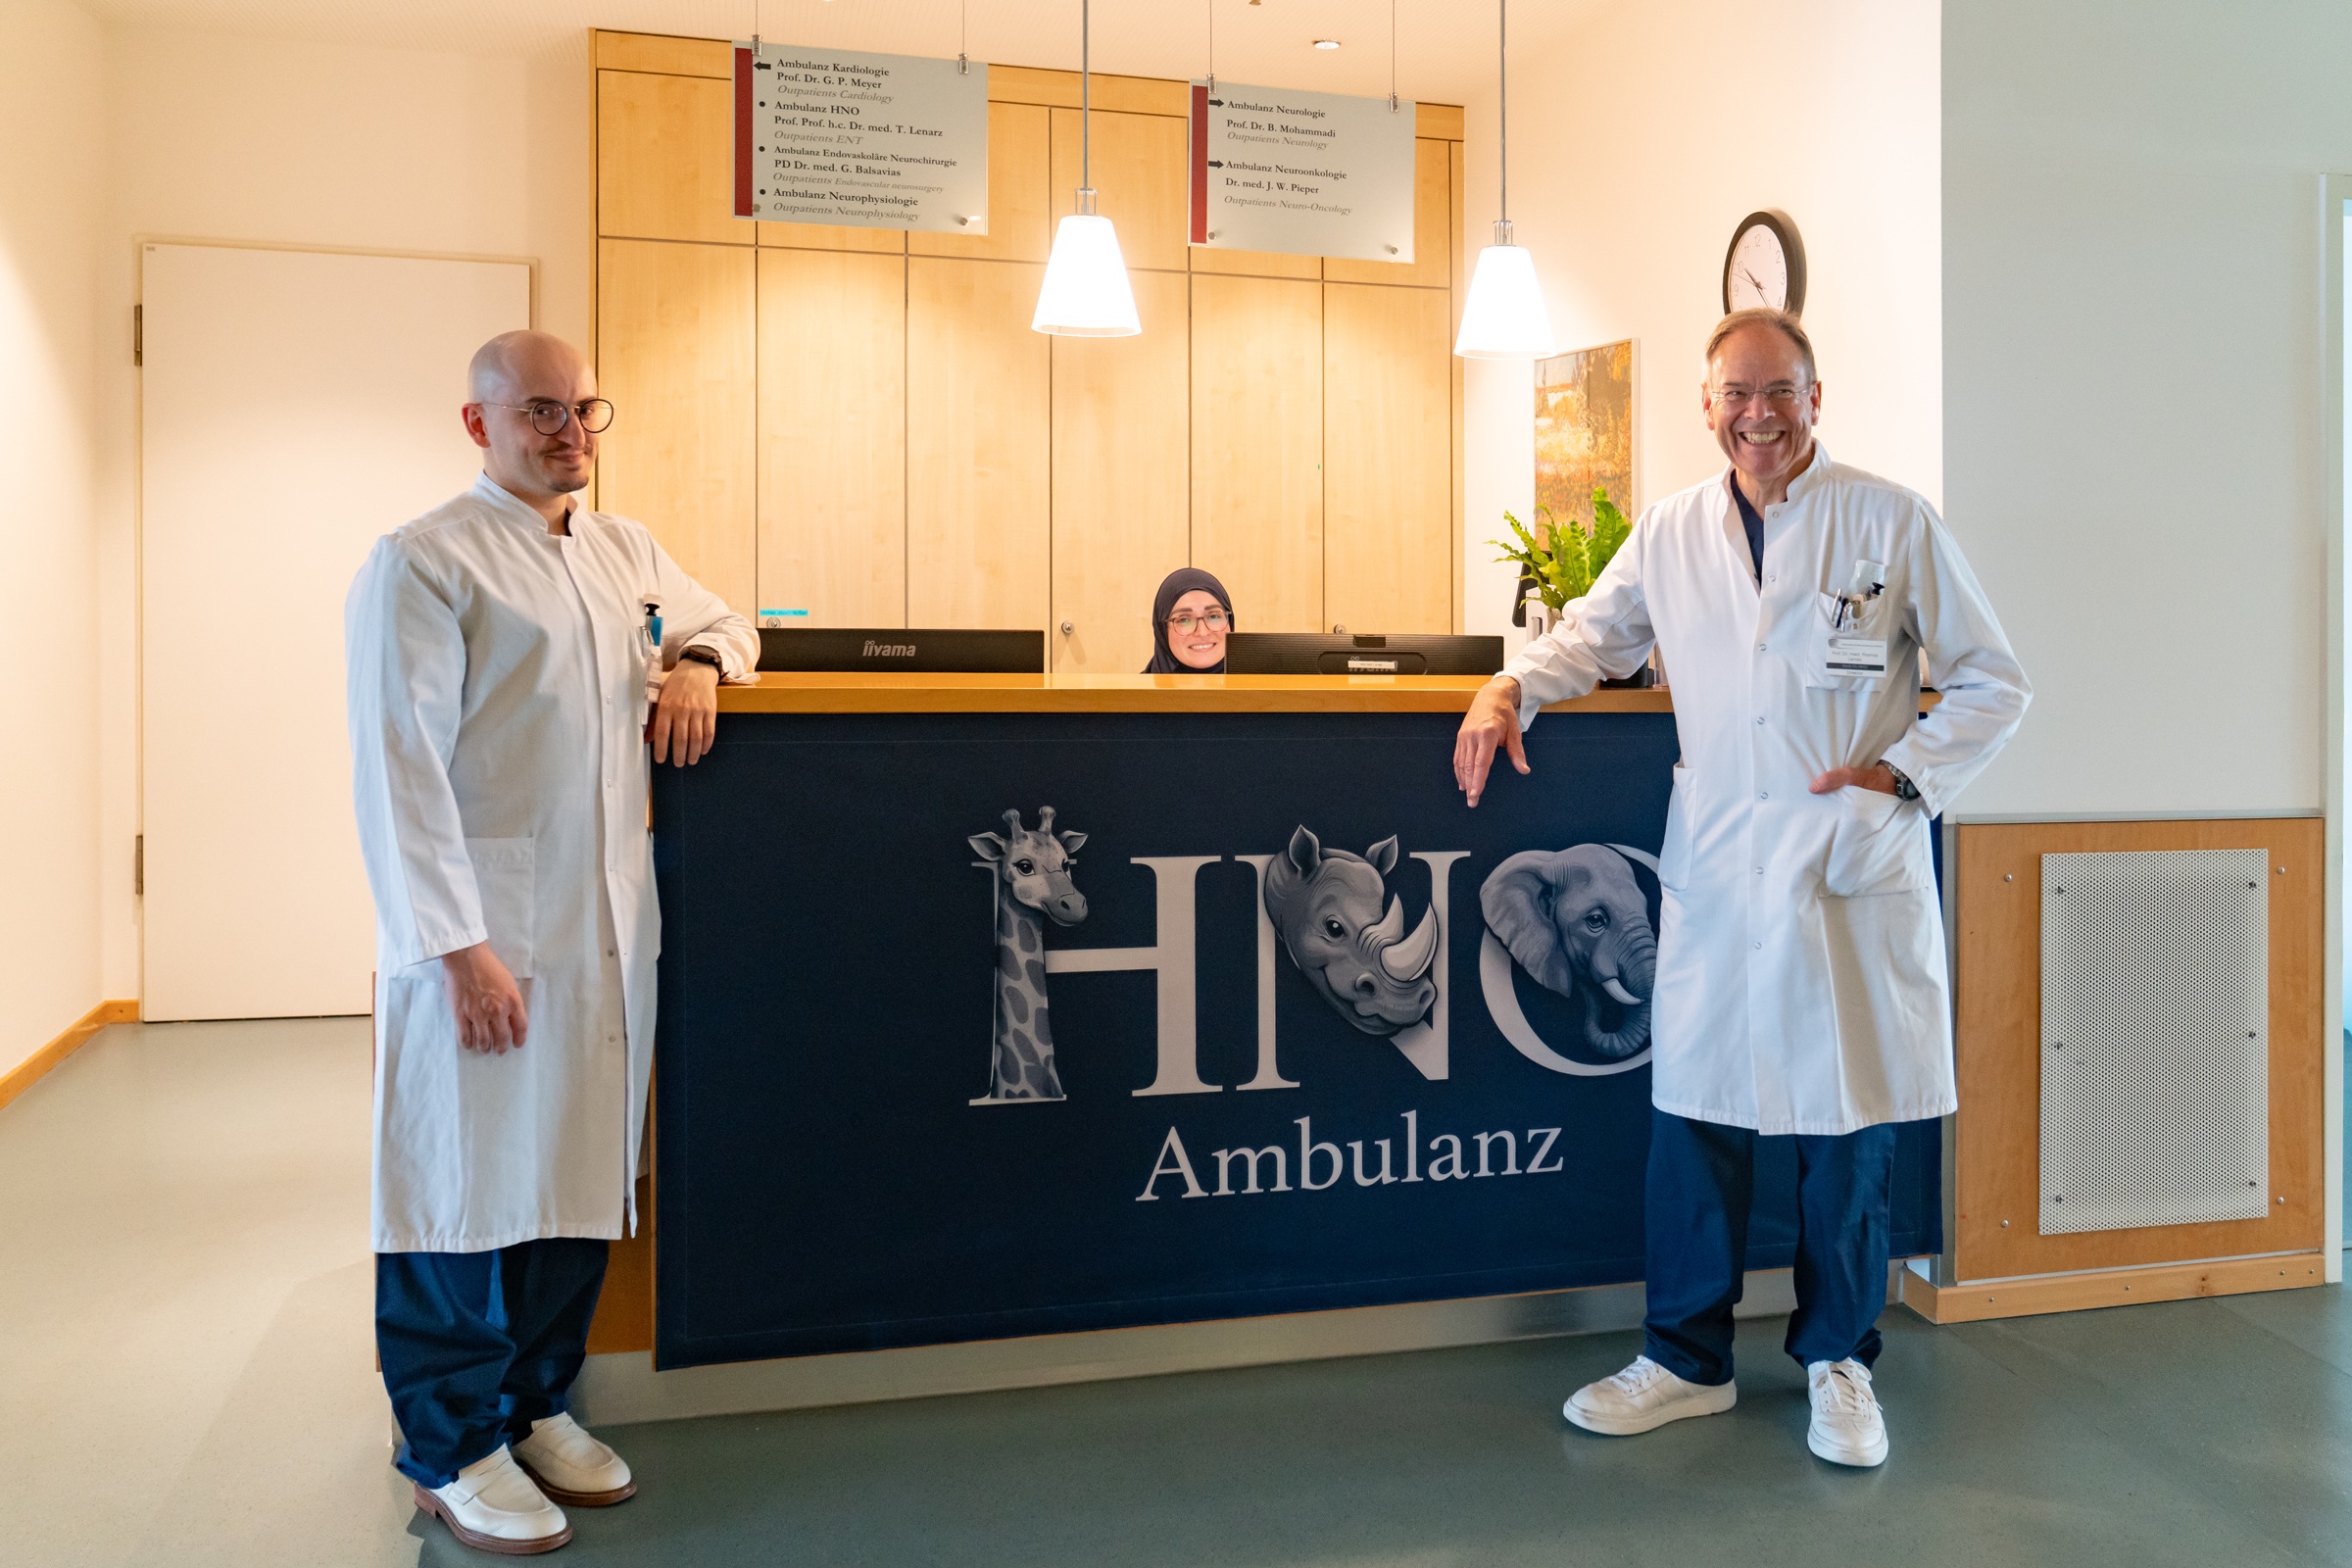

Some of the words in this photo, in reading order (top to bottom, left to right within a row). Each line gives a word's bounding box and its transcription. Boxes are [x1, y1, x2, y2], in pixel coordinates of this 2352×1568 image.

[777, 59, 829, 71] Ambulanz
[832, 63, 890, 77] Kardiologie
[777, 72, 801, 82] Prof.
[804, 74, 820, 83] Dr.
[823, 75, 835, 85] G.
[838, 77, 848, 86] P.
[851, 78, 882, 90] Meyer
[778, 84, 837, 98] Outpatients
[840, 90, 894, 104] Cardiology
[774, 101, 827, 113] Ambulanz
[830, 105, 859, 116] HNO
[1228, 100, 1274, 113] Ambulanz
[1276, 105, 1326, 120] Neurologie
[774, 116, 799, 126] Prof.
[802, 118, 825, 128] Prof.
[828, 120, 846, 129] h.c.
[850, 121, 865, 131] Dr.
[868, 124, 893, 133] med.
[896, 124, 906, 134] T.
[909, 125, 943, 137] Lenarz
[1227, 119, 1248, 129] Prof.
[1250, 122, 1265, 131] Dr.
[1267, 122, 1277, 132] B.
[1280, 124, 1336, 138] Mohammadi
[774, 130, 833, 143] Outpatients
[837, 135, 863, 145] ENT
[1227, 131, 1280, 144] Outpatients
[1282, 136, 1329, 151] Neurology
[774, 146, 820, 157] Ambulanz
[823, 149, 888, 161] Endovaskoläre
[890, 154, 957, 168] Neurochirurgie
[774, 160, 791, 169] PD
[794, 161, 810, 171] Dr.
[812, 164, 838, 172] med.
[841, 165, 853, 173] G.
[856, 165, 901, 176] Balsavias
[1226, 161, 1272, 172] Ambulanz
[1275, 165, 1348, 181] Neuroonkologie
[773, 172, 833, 184] Outpatients
[835, 177, 890, 189] Endovascular
[891, 183, 945, 194] neurosurgery
[1225, 177, 1240, 187] Dr.
[1243, 180, 1264, 189] med.
[1266, 181, 1274, 191] J.
[1276, 182, 1289, 191] W.
[1291, 183, 1319, 195] Pieper
[773, 187, 826, 200] Ambulanz
[829, 191, 918, 208] Neurophysiologie
[1224, 195, 1277, 207] Outpatients
[1279, 200, 1352, 217] Neuro-Oncology
[773, 202, 833, 215] Outpatients
[836, 206, 920, 221] Neurophysiology
[1754, 234, 1761, 247] 12
[1776, 251, 1782, 264] 2
[1781, 271, 1786, 285] 3
[862, 640, 916, 657] iiyama
[968, 833, 1661, 1106] HNO
[1135, 1109, 1565, 1201] Ambulanz
